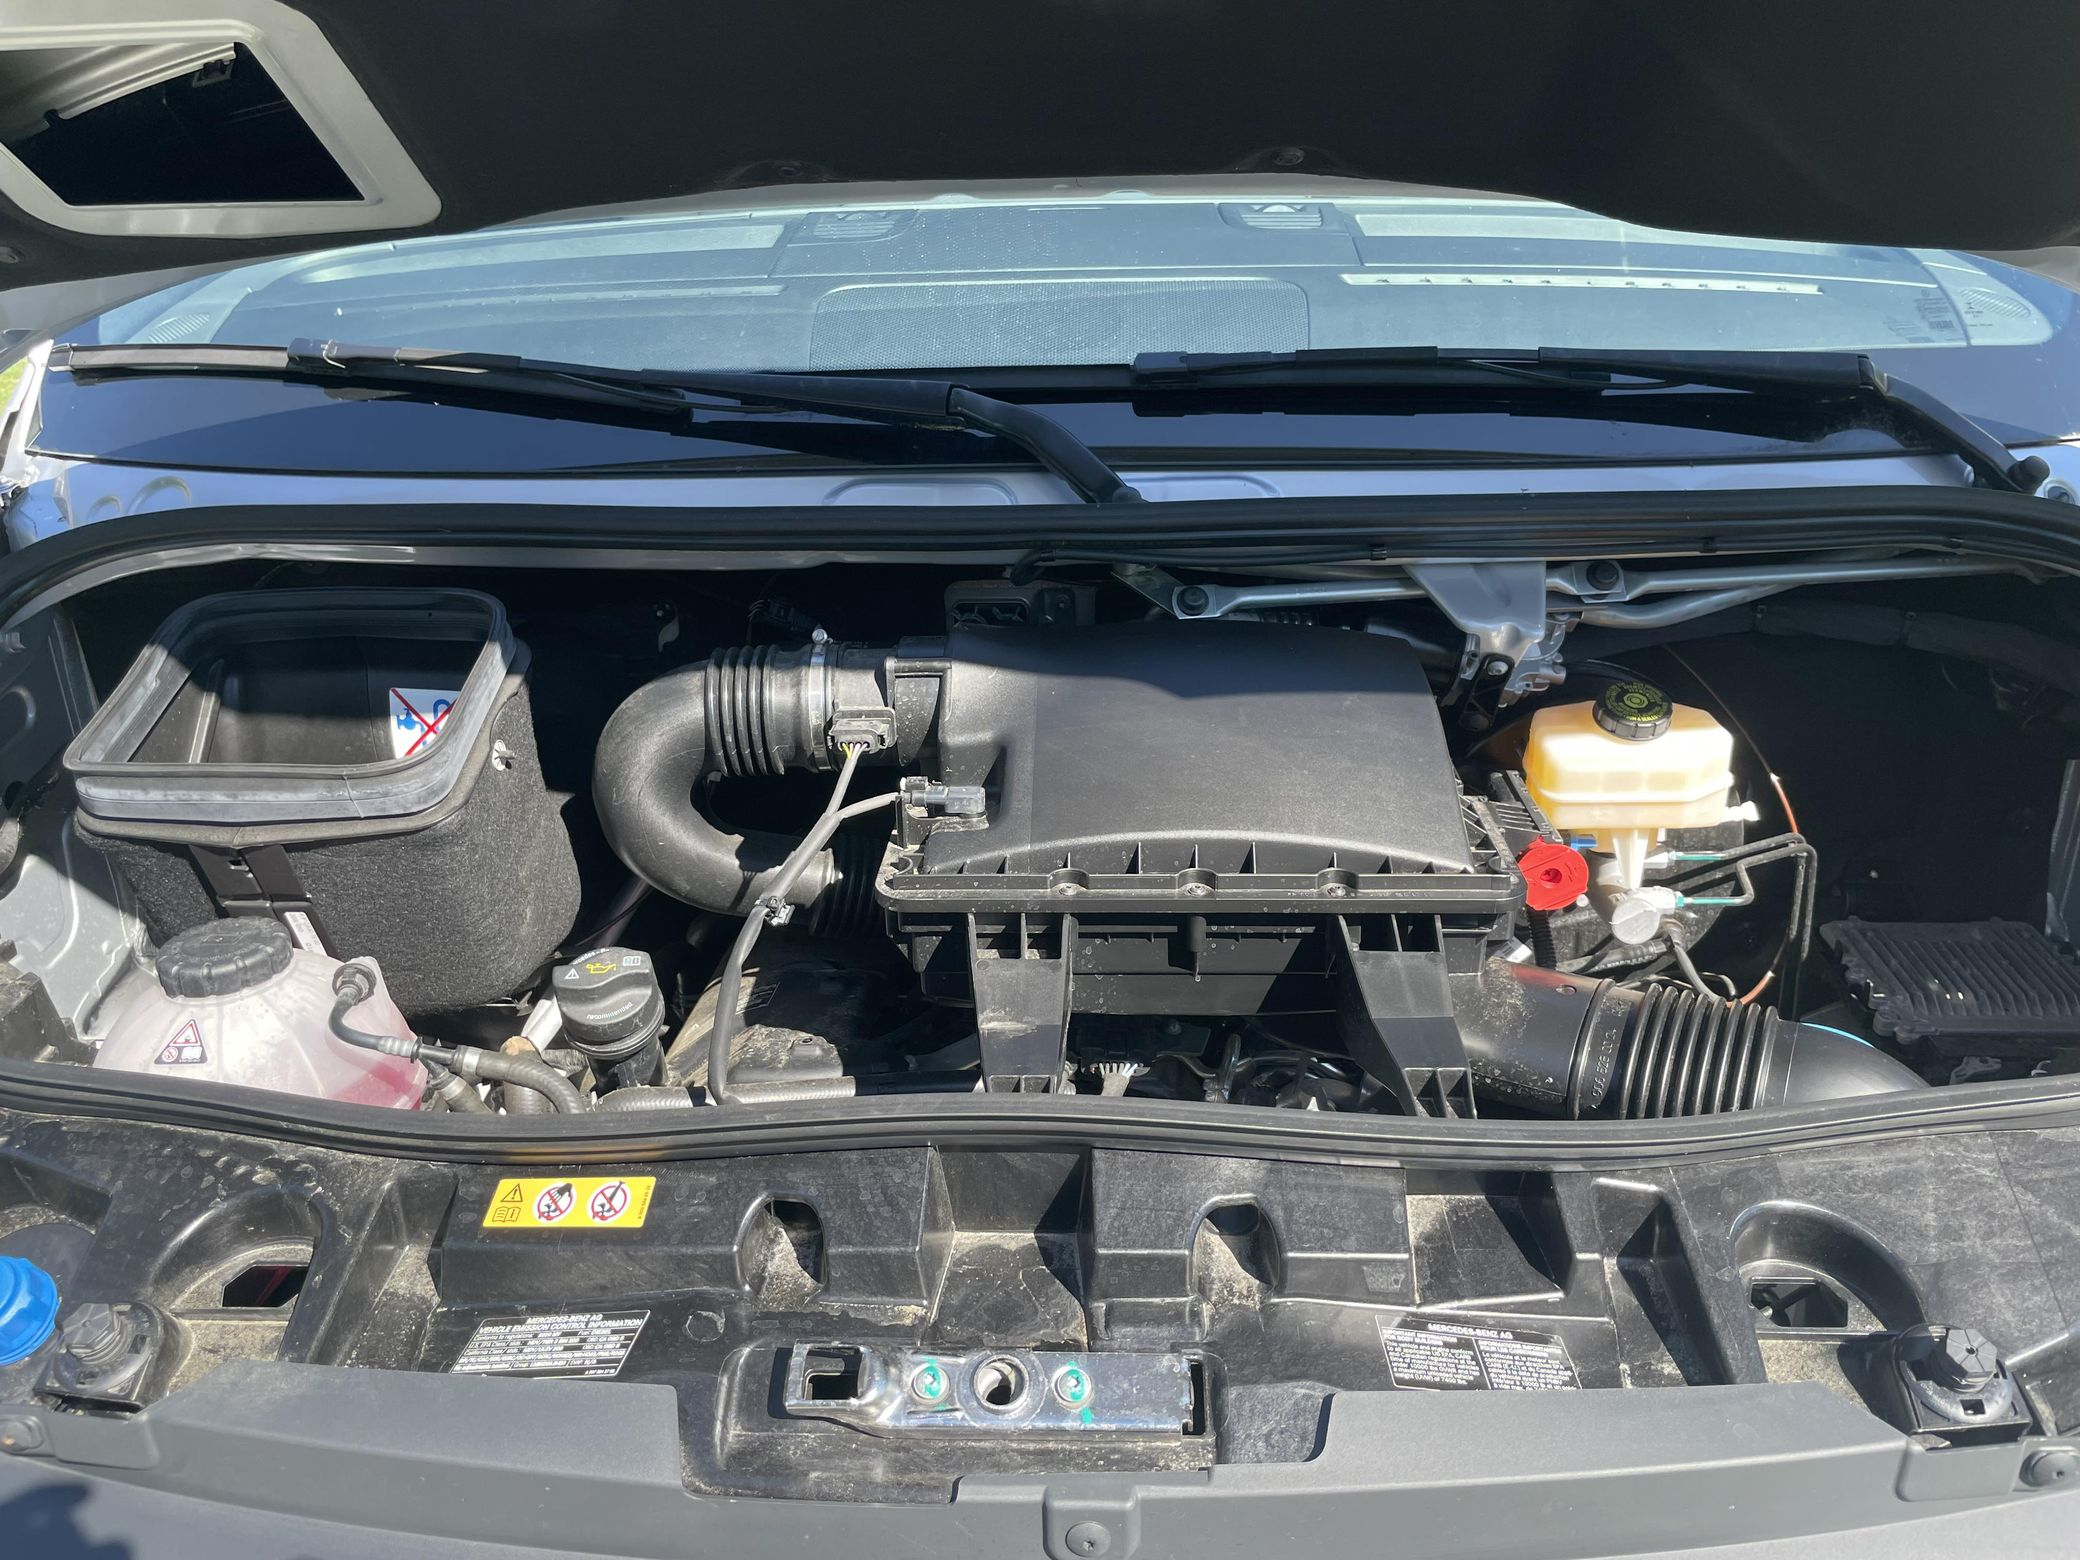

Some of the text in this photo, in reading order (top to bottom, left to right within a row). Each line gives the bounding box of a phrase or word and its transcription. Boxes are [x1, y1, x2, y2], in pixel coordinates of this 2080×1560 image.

[524, 1315, 591, 1324] MERCEDES-BENZ
[511, 1324, 550, 1332] EMISSION
[549, 1322, 588, 1330] CONTROL
[587, 1320, 643, 1328] INFORMATION
[1427, 1323, 1514, 1339] MERCEDES-BENZ AG
[1382, 1329, 1458, 1342] IMPORTANT INFORMATION
[1411, 1359, 1447, 1367] manufacture
